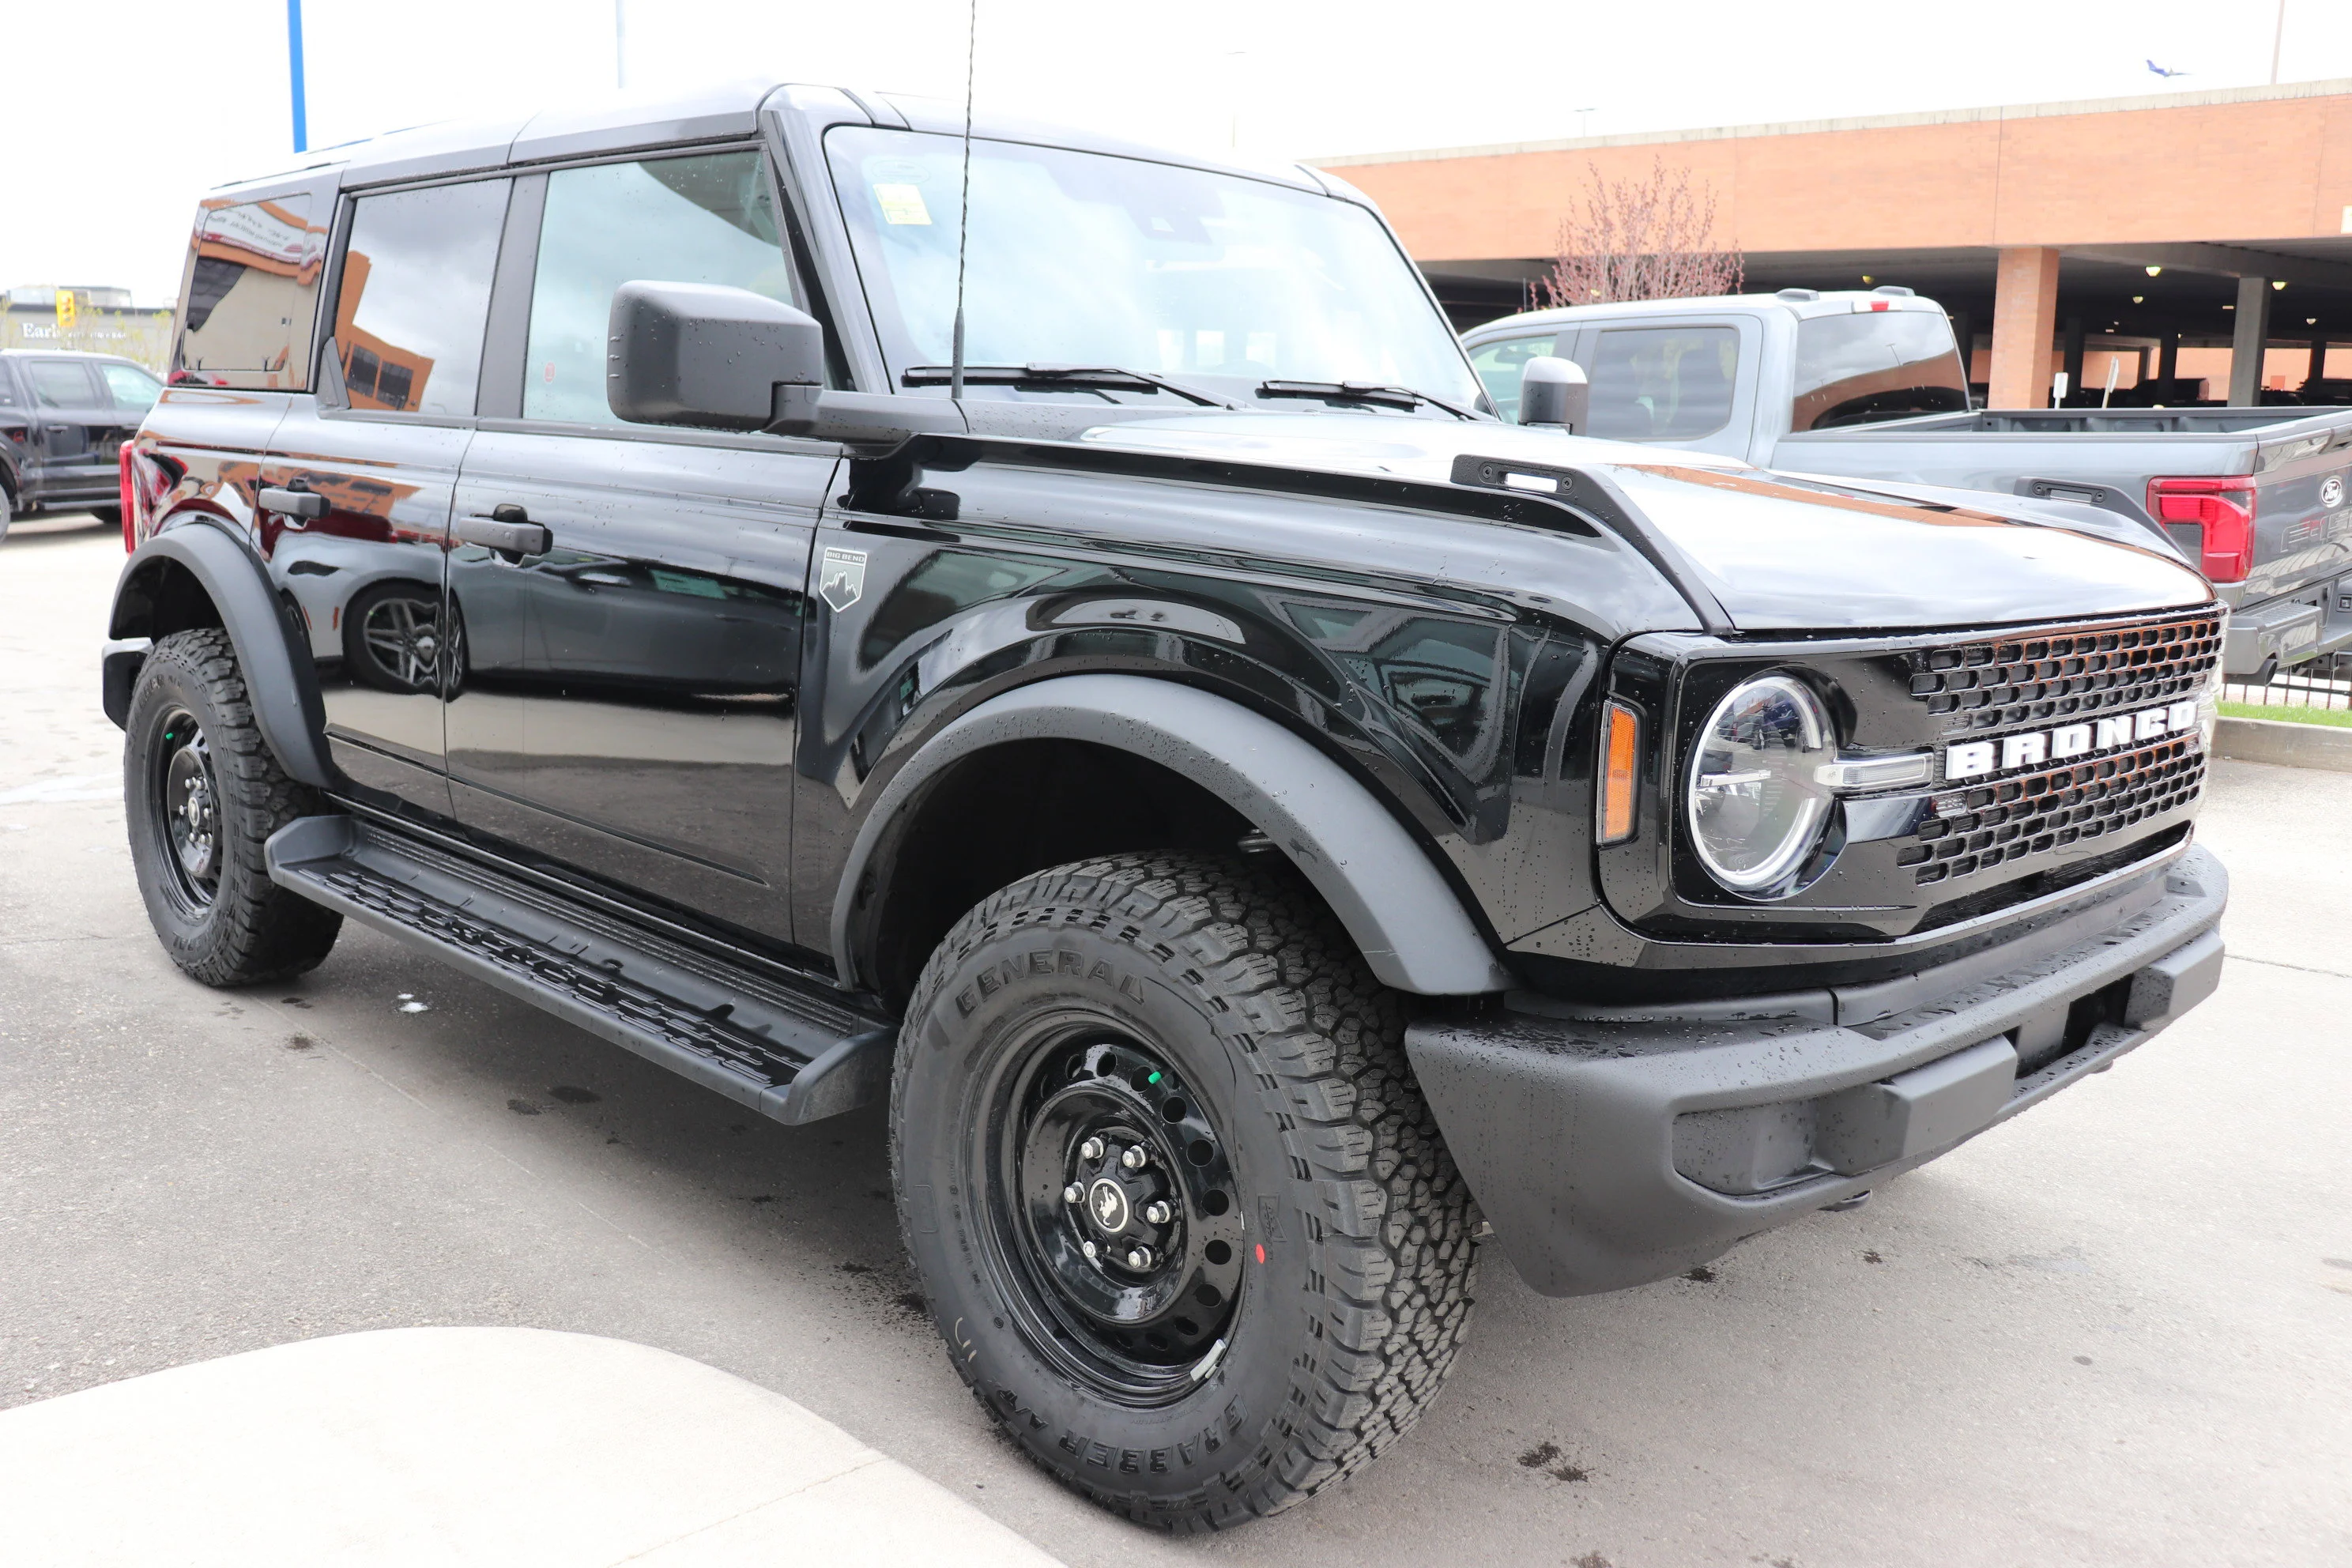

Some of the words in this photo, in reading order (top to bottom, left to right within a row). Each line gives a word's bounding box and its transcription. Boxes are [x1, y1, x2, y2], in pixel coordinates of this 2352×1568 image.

[842, 553, 865, 563] BEND
[1945, 701, 2198, 781] BRONCO
[955, 948, 1145, 1020] GENERAL
[1058, 1394, 1249, 1475] GRABBER
